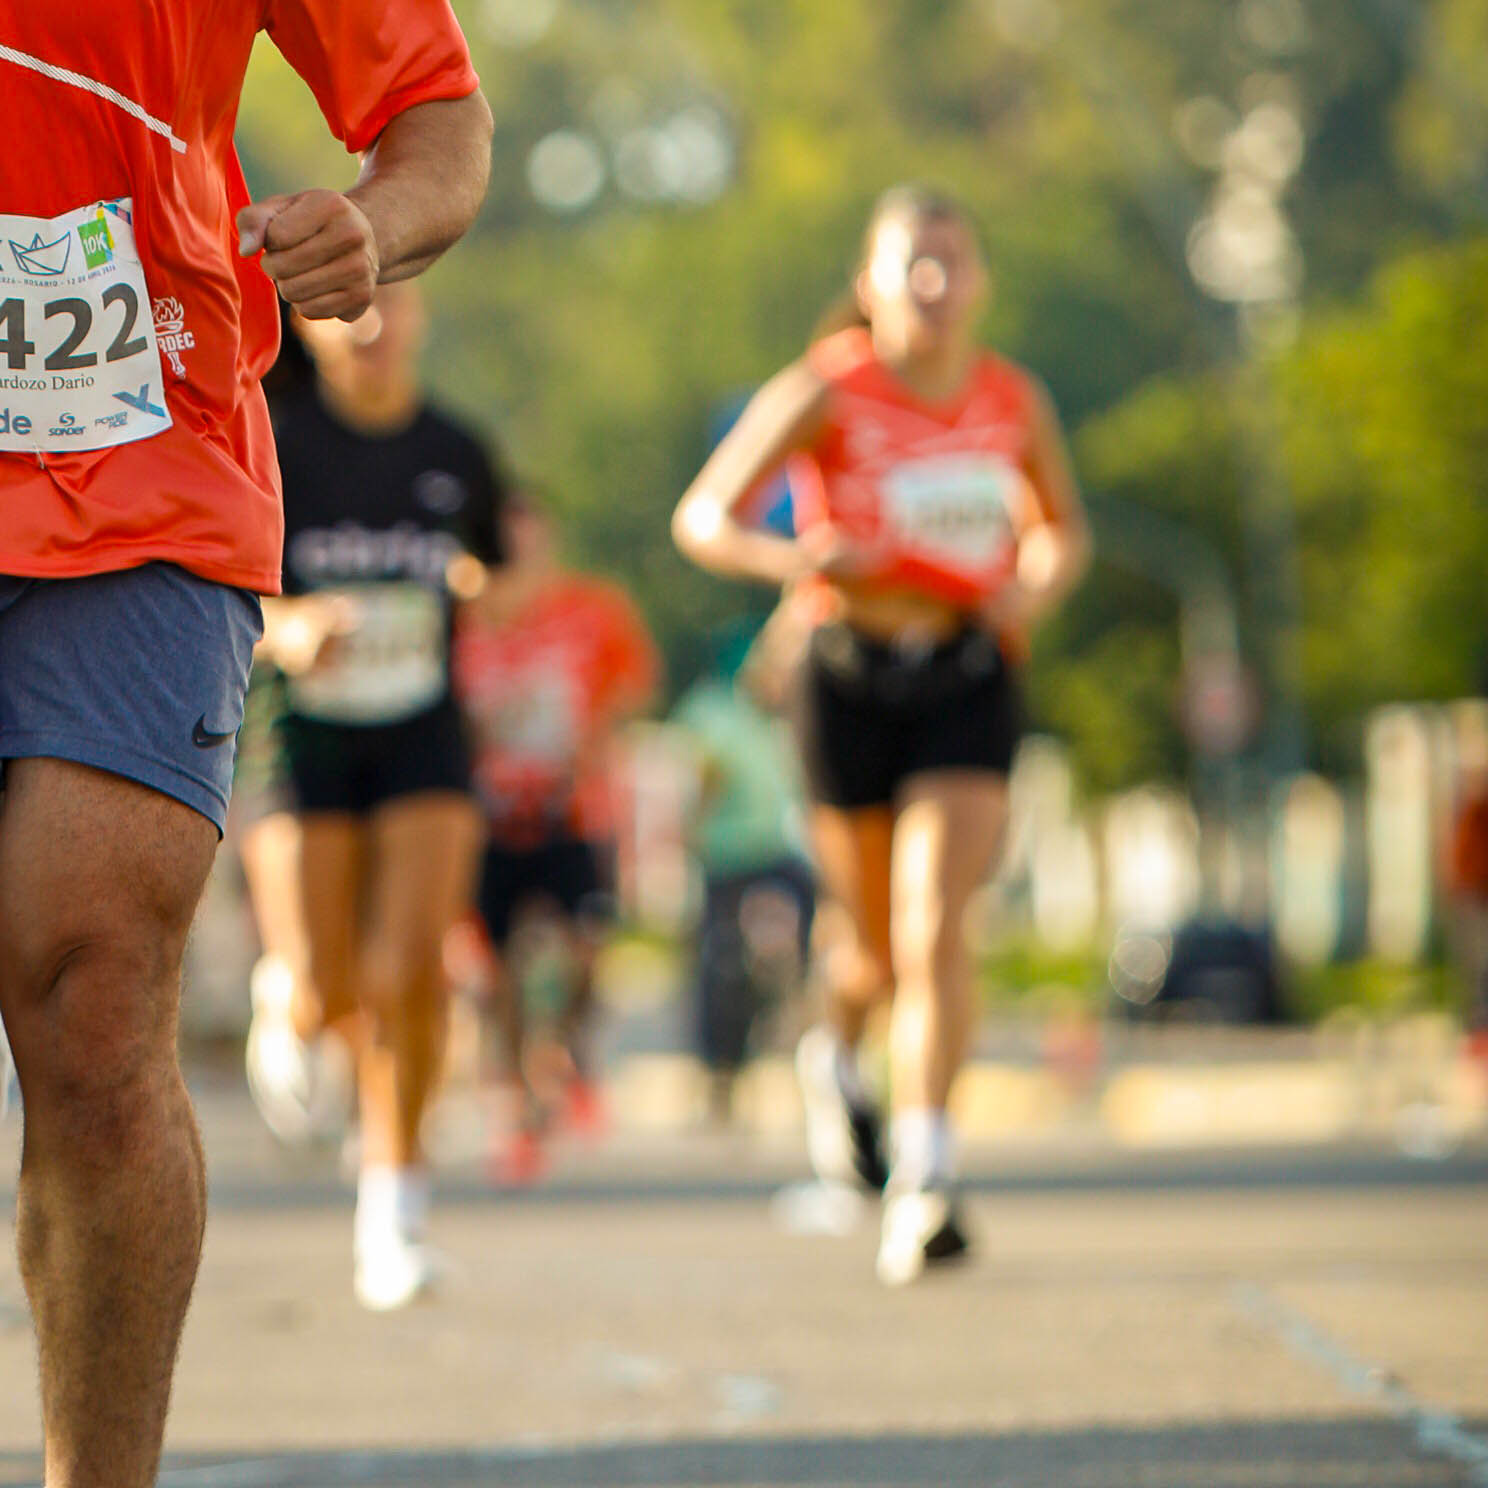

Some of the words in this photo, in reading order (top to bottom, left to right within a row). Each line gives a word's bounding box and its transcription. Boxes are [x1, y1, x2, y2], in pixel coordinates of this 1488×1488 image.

[83, 231, 109, 256] 10K
[24, 278, 58, 287] ROSARIO
[52, 373, 95, 390] Dario
